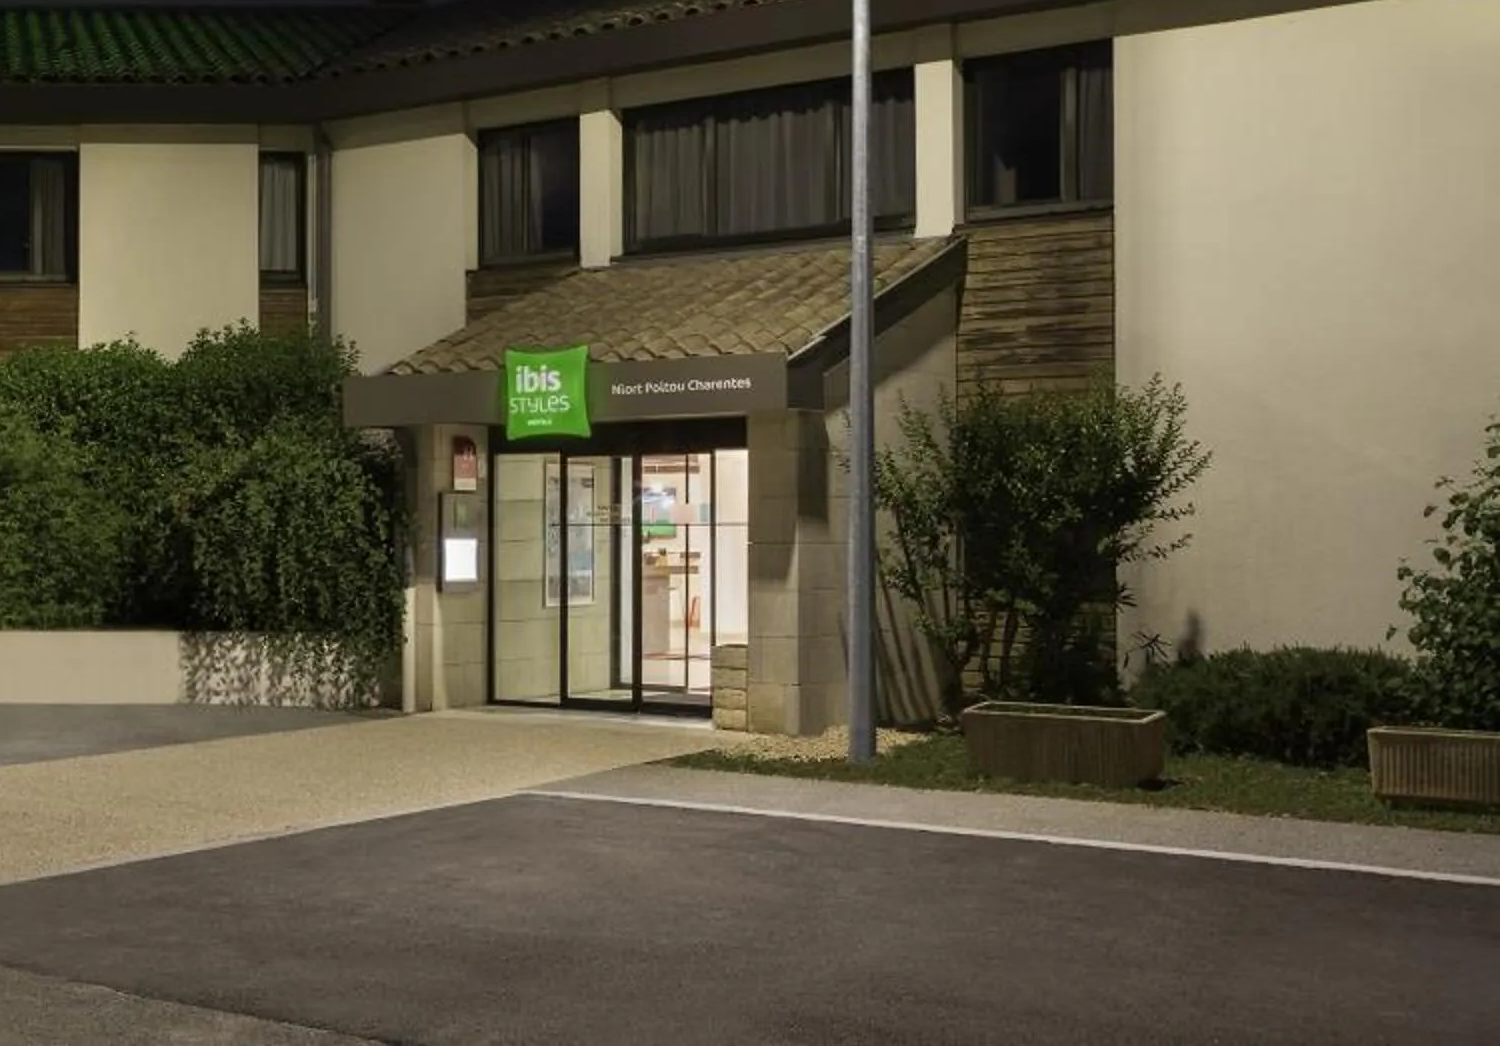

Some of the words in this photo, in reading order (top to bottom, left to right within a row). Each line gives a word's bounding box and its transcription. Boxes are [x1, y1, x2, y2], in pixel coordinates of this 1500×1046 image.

[515, 364, 562, 394] ibis
[611, 383, 644, 395] Niort
[645, 380, 685, 394] Poitou
[687, 377, 752, 392] Charentes
